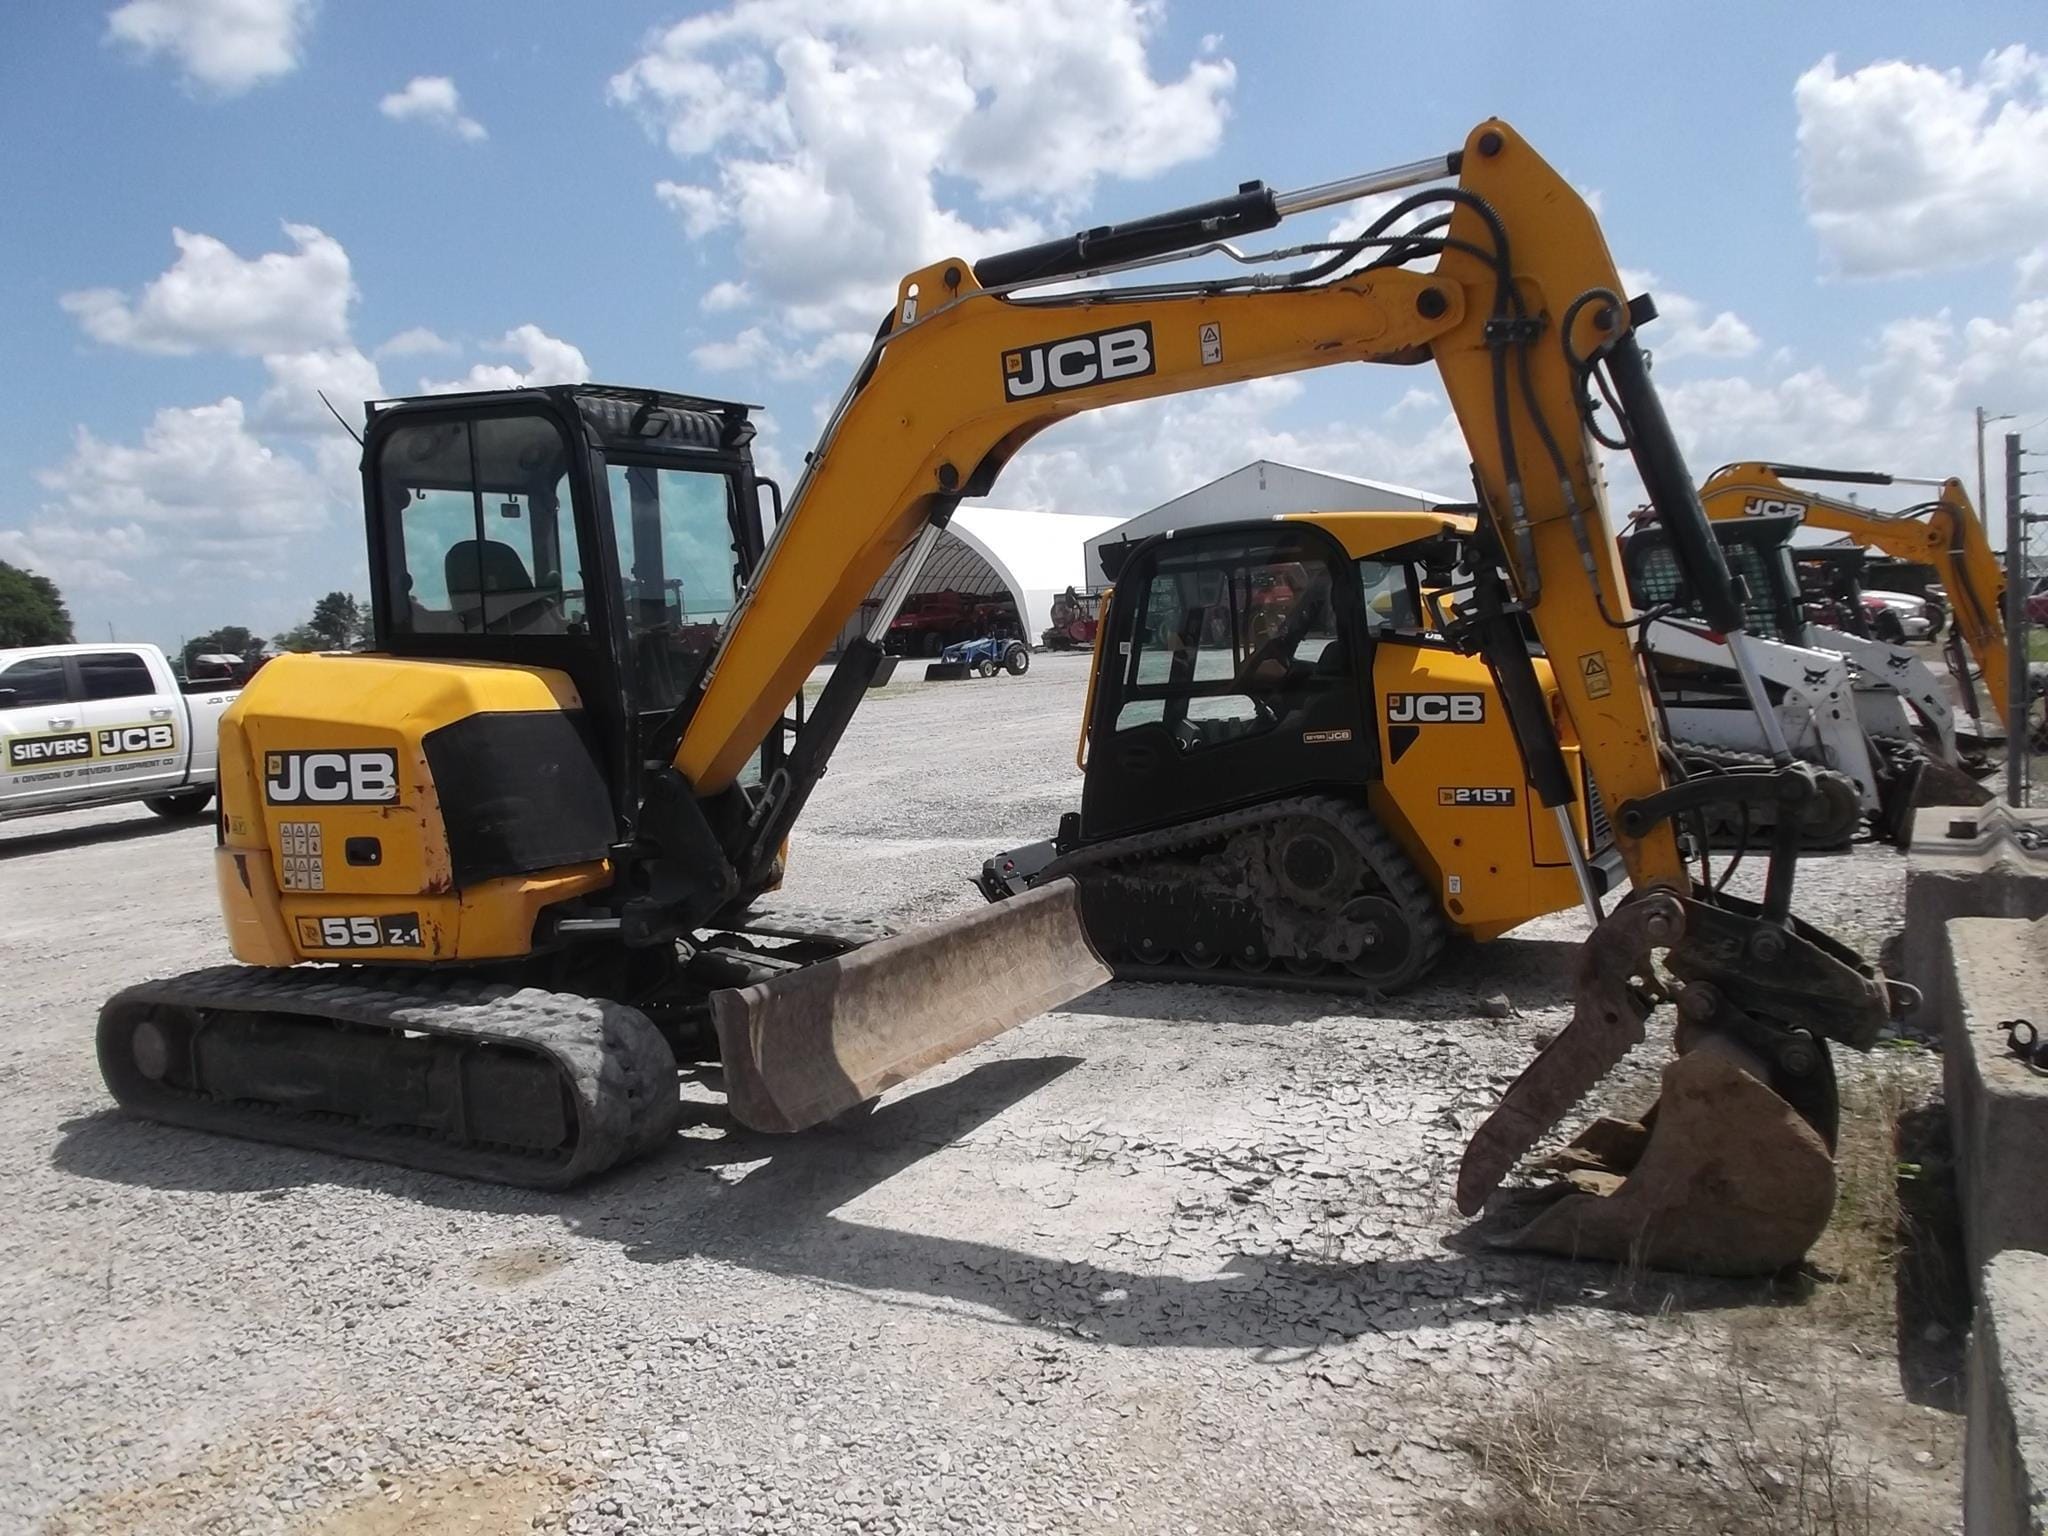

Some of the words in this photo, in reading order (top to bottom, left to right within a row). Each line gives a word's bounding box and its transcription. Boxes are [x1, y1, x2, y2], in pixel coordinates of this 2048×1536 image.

[1008, 329, 1150, 396] JCB
[1389, 695, 1483, 721] JCB
[13, 738, 89, 760] SIEVERS
[101, 726, 173, 754] JCB
[22, 773, 61, 783] DIVISION
[63, 770, 75, 778] OF
[78, 766, 112, 776] SIEVERS
[115, 760, 160, 771] EQUIPMENT
[268, 753, 396, 800] JCB
[1456, 789, 1511, 801] 215T
[322, 917, 379, 945] 55
[389, 928, 420, 944] Z-1
